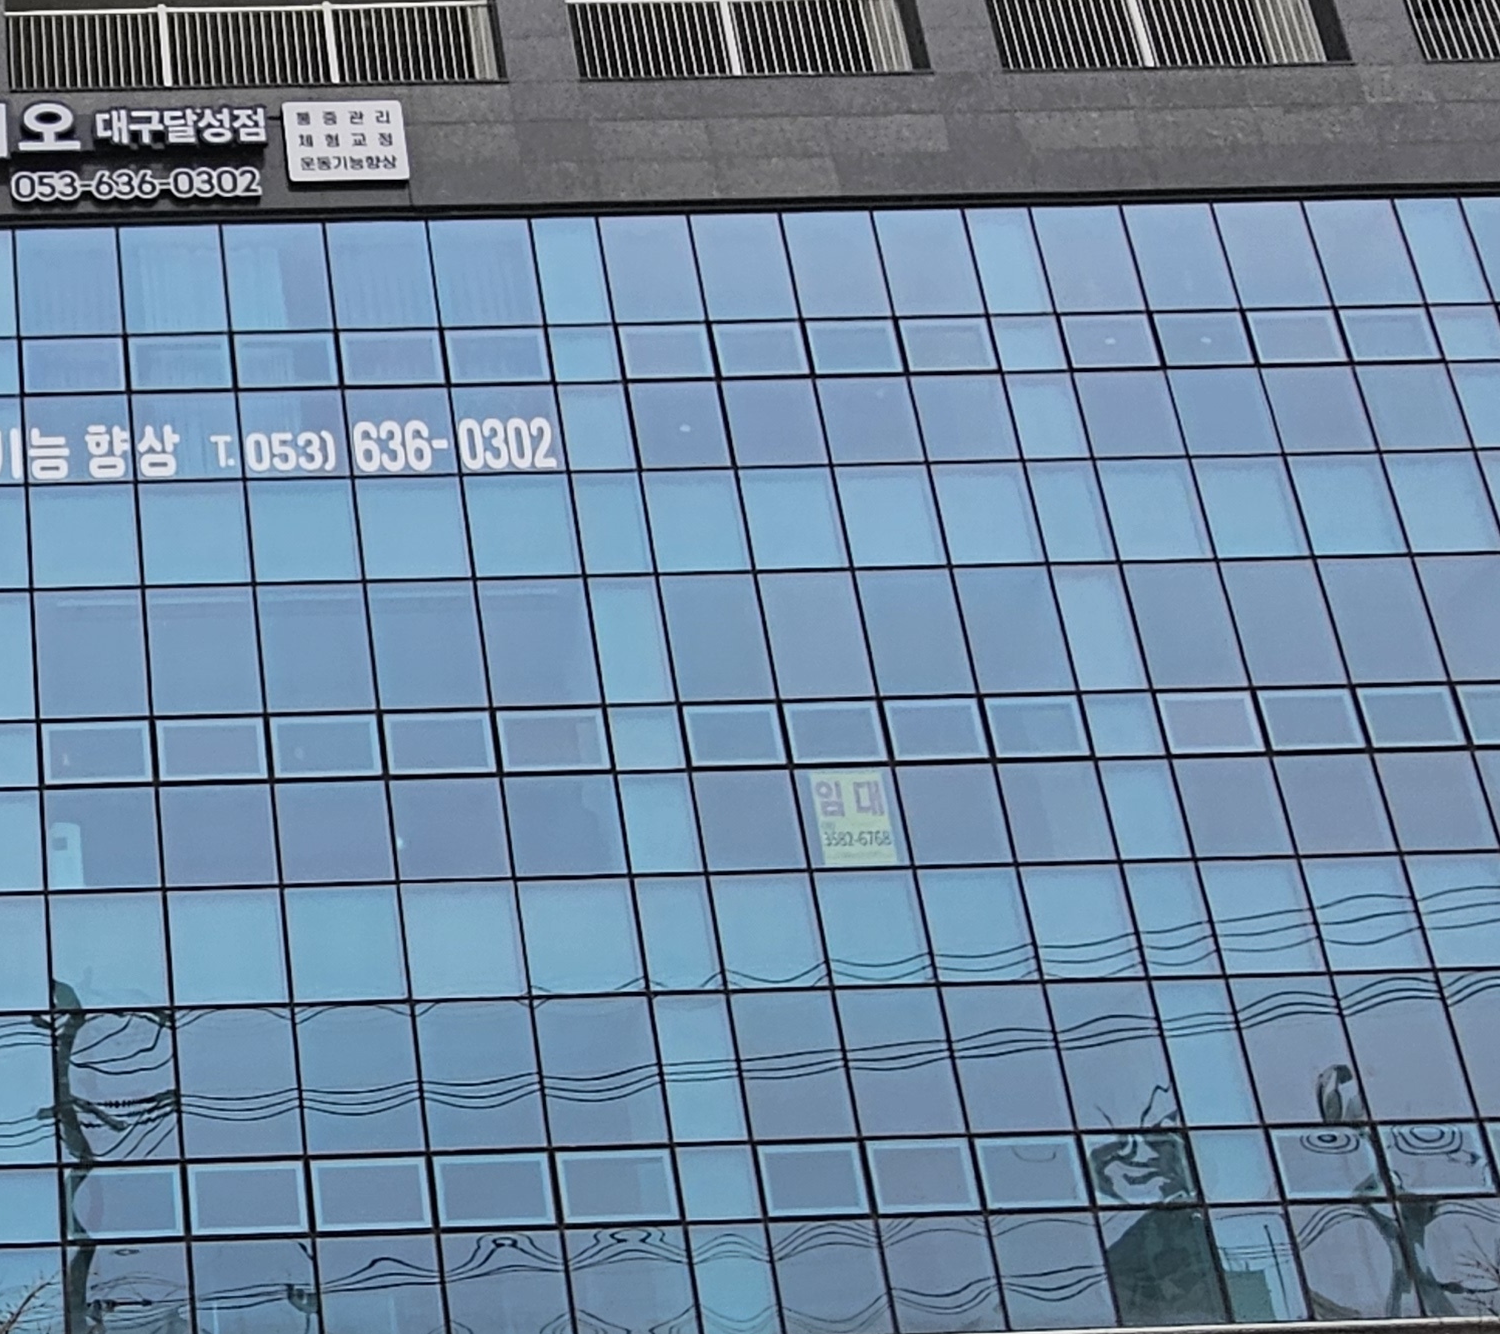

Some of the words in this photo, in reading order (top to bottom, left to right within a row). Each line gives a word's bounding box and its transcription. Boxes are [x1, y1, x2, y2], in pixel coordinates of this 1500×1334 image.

[95, 107, 267, 147] 대구달성점
[11, 167, 263, 202] 053-636-0302
[84, 423, 180, 479] 향상
[352, 416, 558, 473] 636-0302
